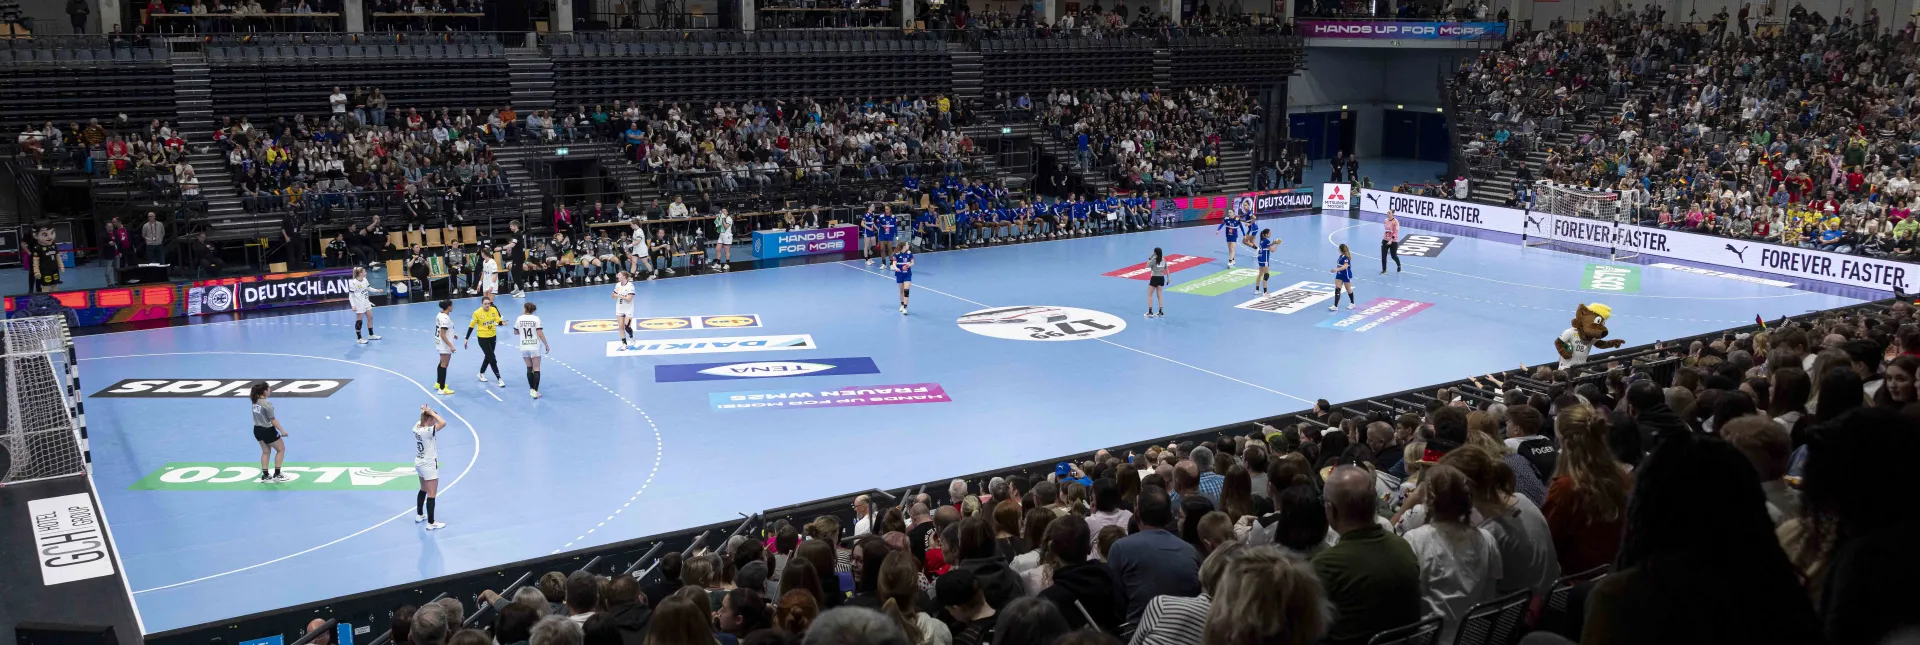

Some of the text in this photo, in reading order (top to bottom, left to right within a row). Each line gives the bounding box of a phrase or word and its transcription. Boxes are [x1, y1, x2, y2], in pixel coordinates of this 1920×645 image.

[1315, 25, 1372, 34] HANDS
[1375, 25, 1398, 34] UP
[1402, 26, 1435, 35] FOR
[1258, 194, 1312, 210] DEUTSCHLAND
[1389, 196, 1483, 224] FOREVER. FASTER.
[778, 230, 846, 244] HANDS UP
[1617, 228, 1670, 252] FASTER.
[778, 241, 844, 254] FOR MORE
[1761, 248, 1836, 277] FOREVER.
[1841, 259, 1909, 288] FASTER.
[245, 278, 350, 303] DEUTSCHLAN
[523, 328, 533, 339] 14
[730, 365, 810, 374] TENA
[730, 387, 929, 401] FRAUEN WM25
[870, 394, 943, 402] HANDS
[160, 466, 416, 486] ALSCO
[36, 511, 60, 532] HOTEL
[68, 506, 94, 527] GROUP
[41, 529, 105, 568] GCH
